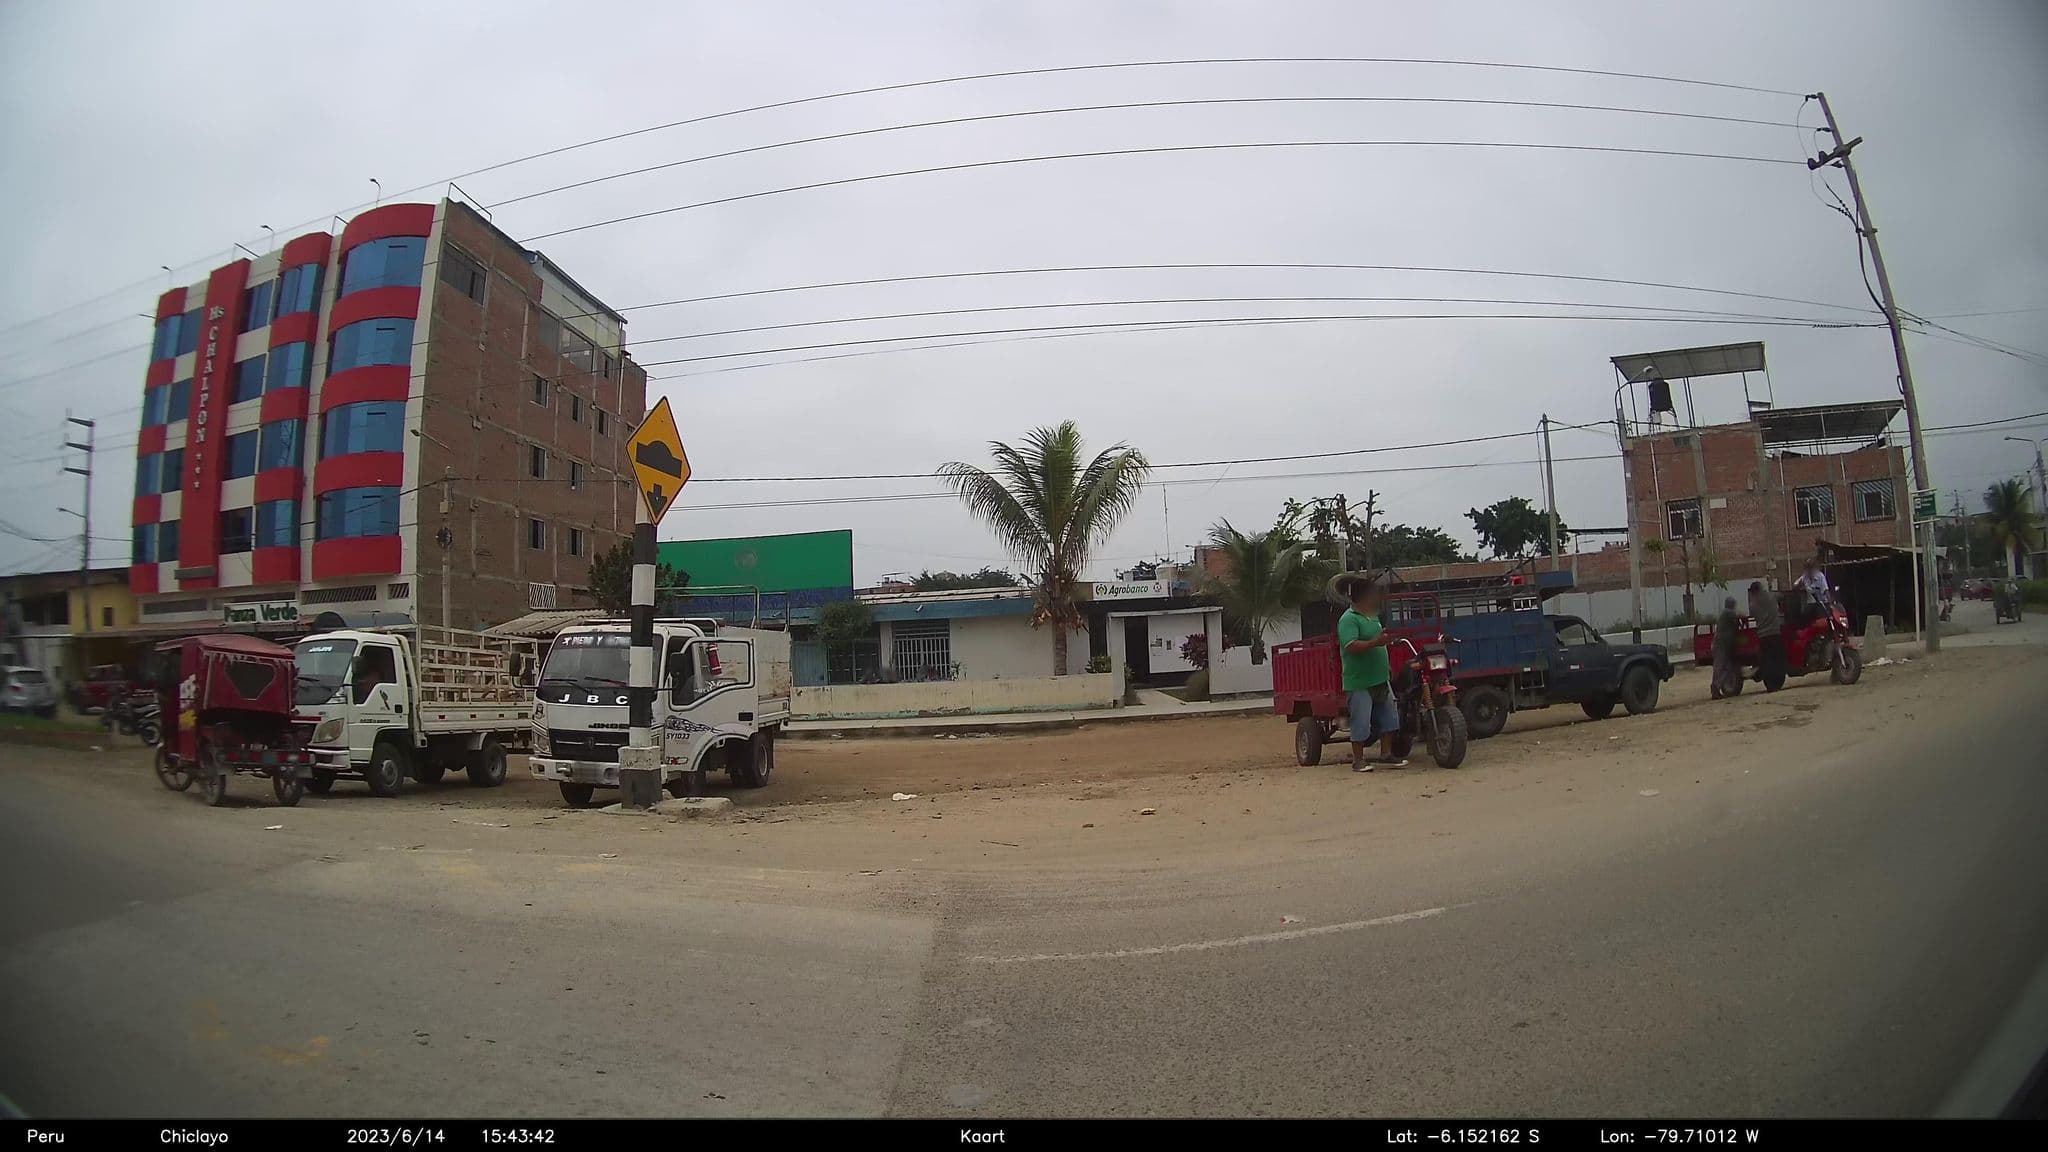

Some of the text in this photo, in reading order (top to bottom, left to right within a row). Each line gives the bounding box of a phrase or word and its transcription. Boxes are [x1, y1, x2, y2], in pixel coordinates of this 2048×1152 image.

[196, 326, 218, 444] CHALPON
[1108, 584, 1149, 597] Agrobanco
[260, 602, 298, 621] Verde
